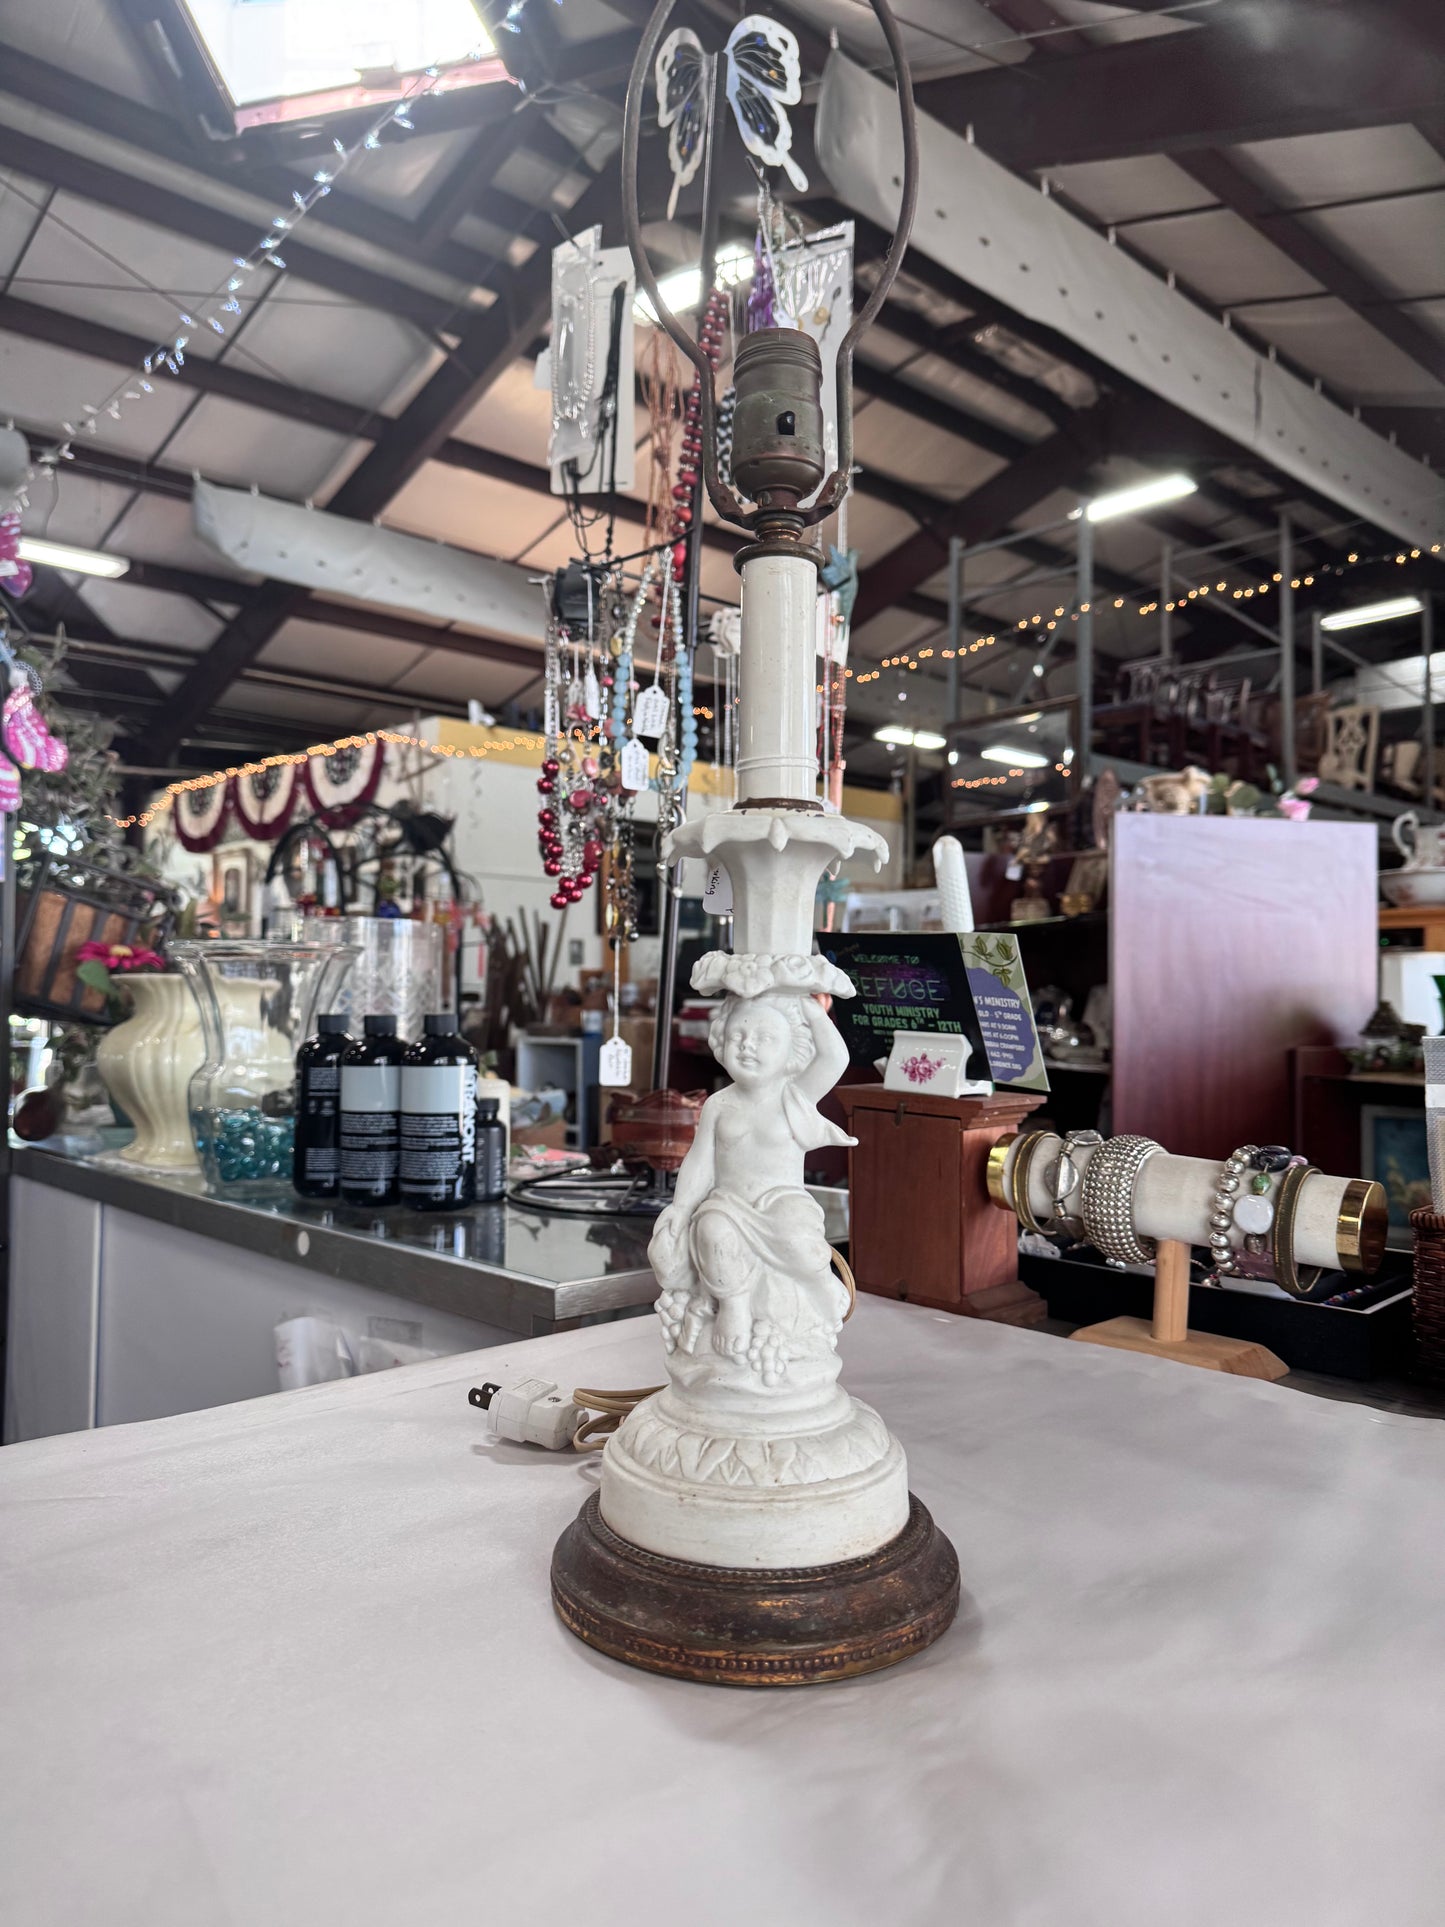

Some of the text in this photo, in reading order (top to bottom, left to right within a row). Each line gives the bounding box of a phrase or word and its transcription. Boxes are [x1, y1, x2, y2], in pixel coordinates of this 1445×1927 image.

[984, 996, 1020, 1009] MINISTRY
[863, 1003, 940, 1019] YOUTH MINISTRY
[1003, 1012, 1022, 1021] GRADE
[852, 1015, 871, 1026] FOR
[872, 1016, 908, 1029] GRADES
[937, 1021, 962, 1032] 12TH
